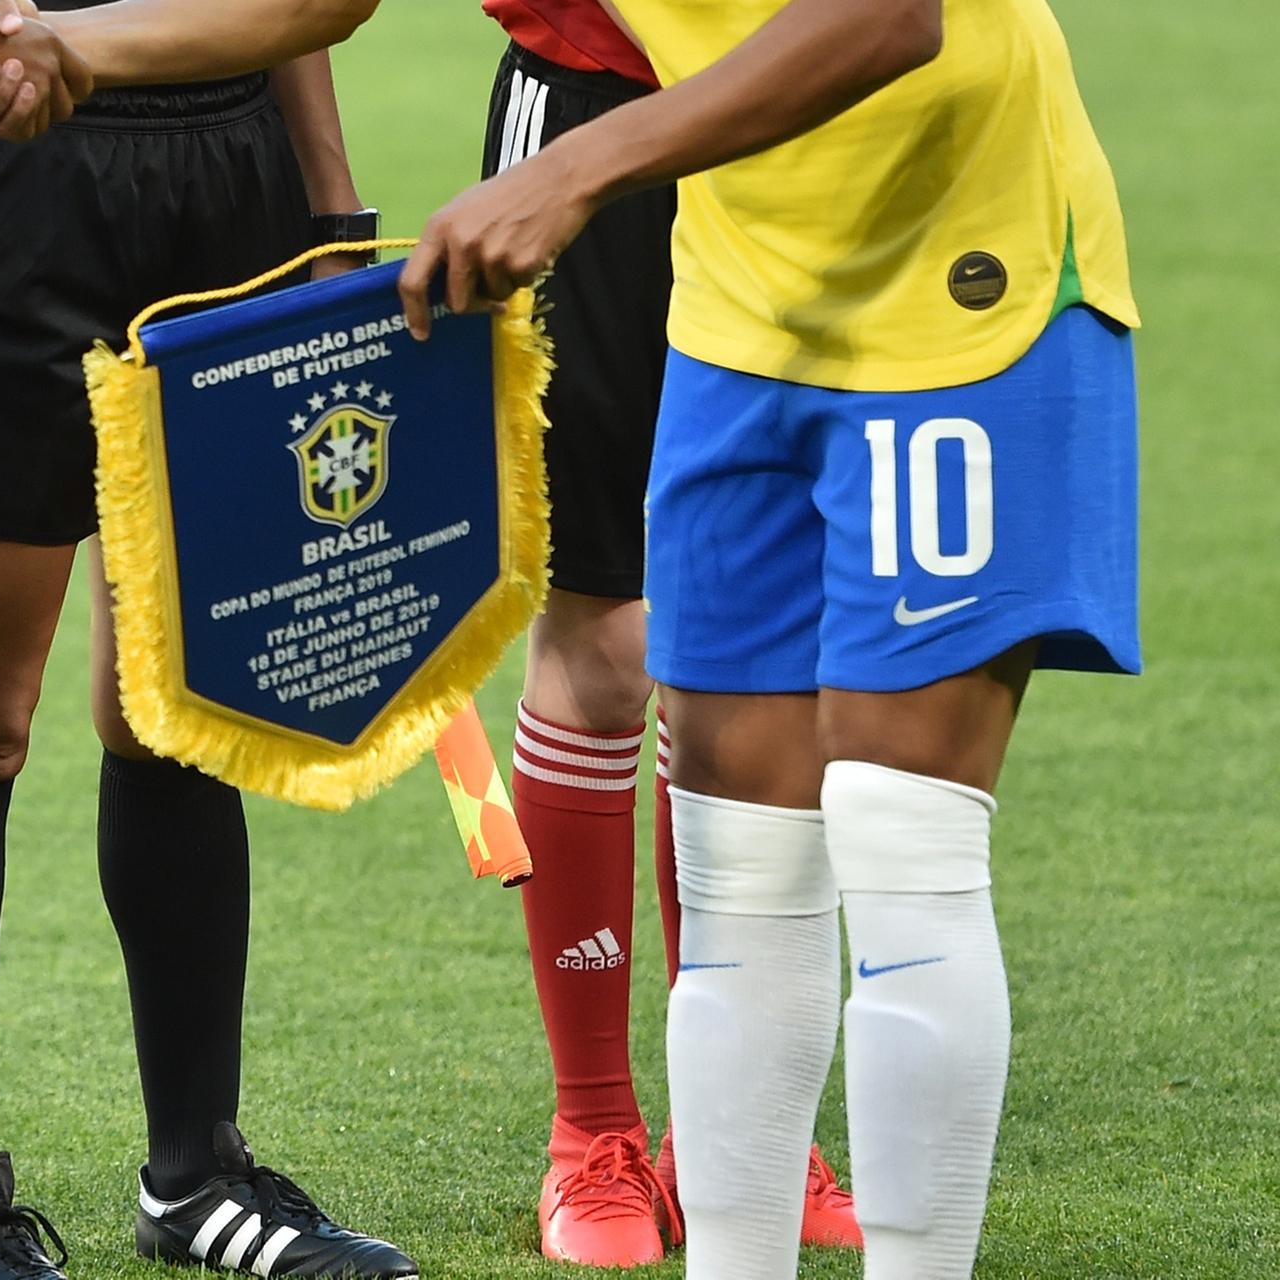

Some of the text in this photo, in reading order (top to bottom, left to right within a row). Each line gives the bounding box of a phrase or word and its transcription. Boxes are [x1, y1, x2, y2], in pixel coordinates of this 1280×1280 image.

[192, 332, 348, 389] CONFEDERAÇÃO
[272, 341, 392, 389] DE FUTEBOL
[329, 454, 361, 473] CBF
[865, 418, 994, 577] 10
[211, 520, 470, 620] COPA DO MUNDO DE FUTEBOL FEMININO
[302, 520, 392, 566] BRASIL
[267, 584, 419, 647] ITÁLIA vs BRASIL
[294, 569, 392, 614] FRANÇA 2019
[248, 594, 439, 673] 18 DE JUNHO DE 2019
[257, 617, 431, 690] STADE DU HAINAUT
[277, 643, 412, 703] VALENCIENNES
[308, 674, 380, 712] FRANÇA
[556, 952, 626, 971] adidas
